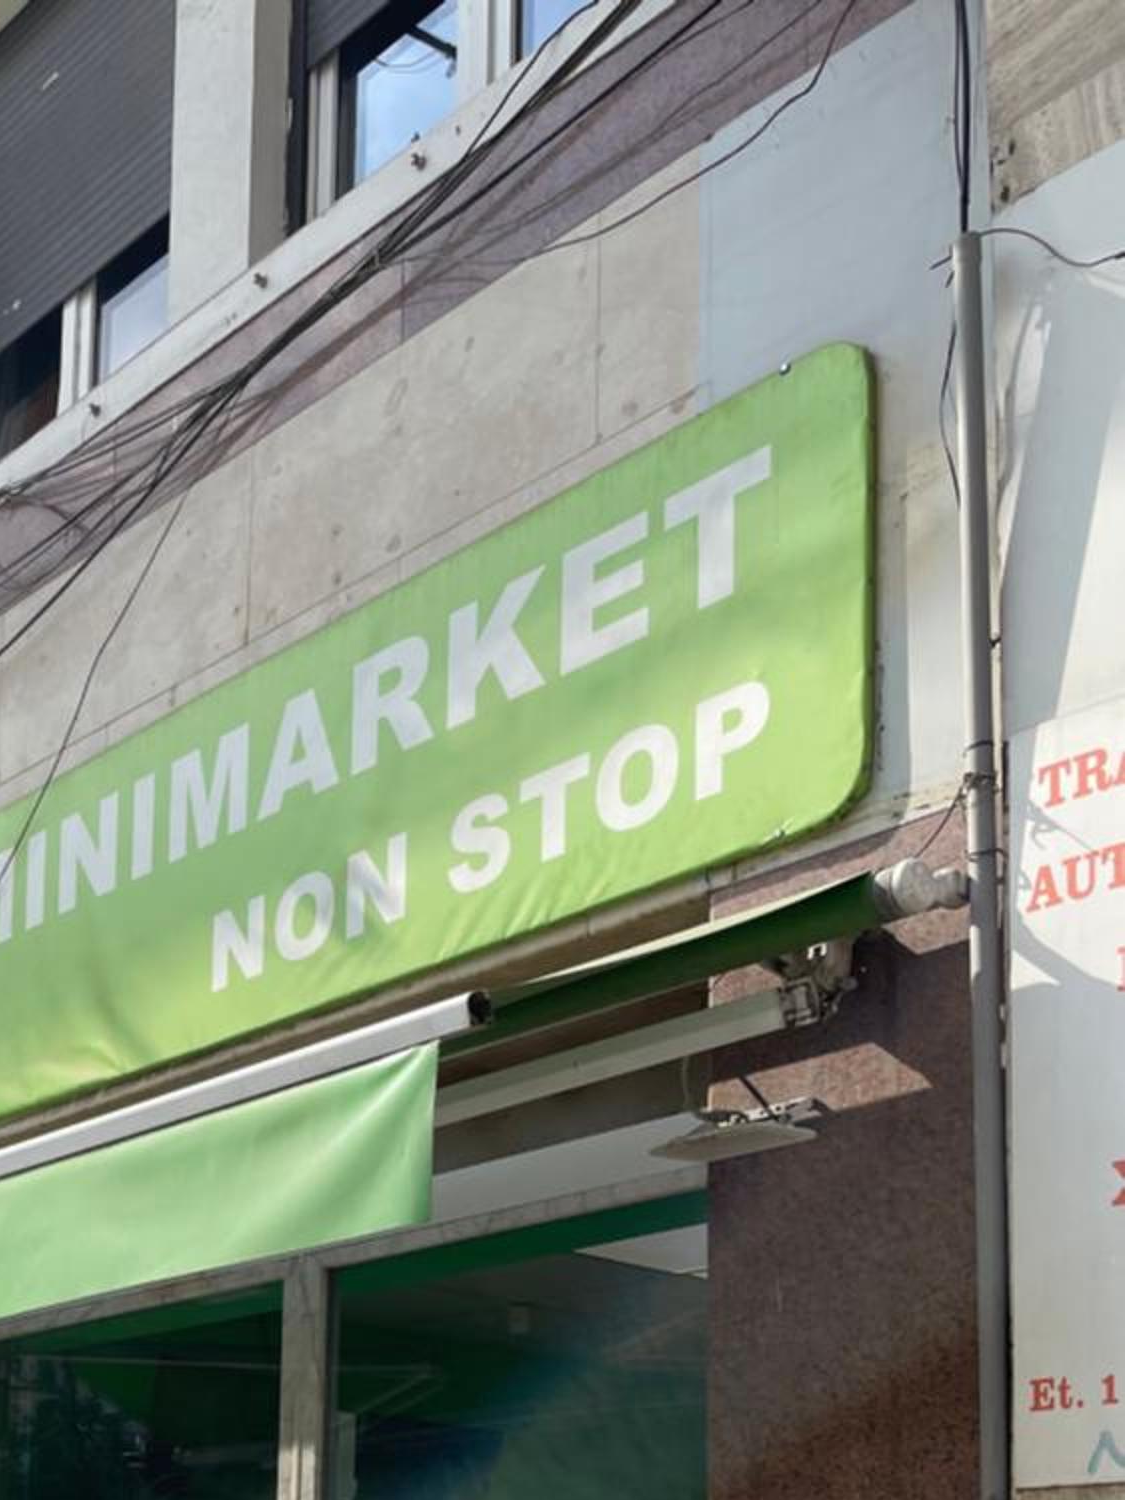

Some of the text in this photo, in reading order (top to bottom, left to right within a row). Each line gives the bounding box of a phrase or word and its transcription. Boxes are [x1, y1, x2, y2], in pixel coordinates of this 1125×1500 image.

[448, 682, 770, 893] STOP
[210, 832, 408, 992] NON
[1029, 1374, 1119, 1412] Et. 1
